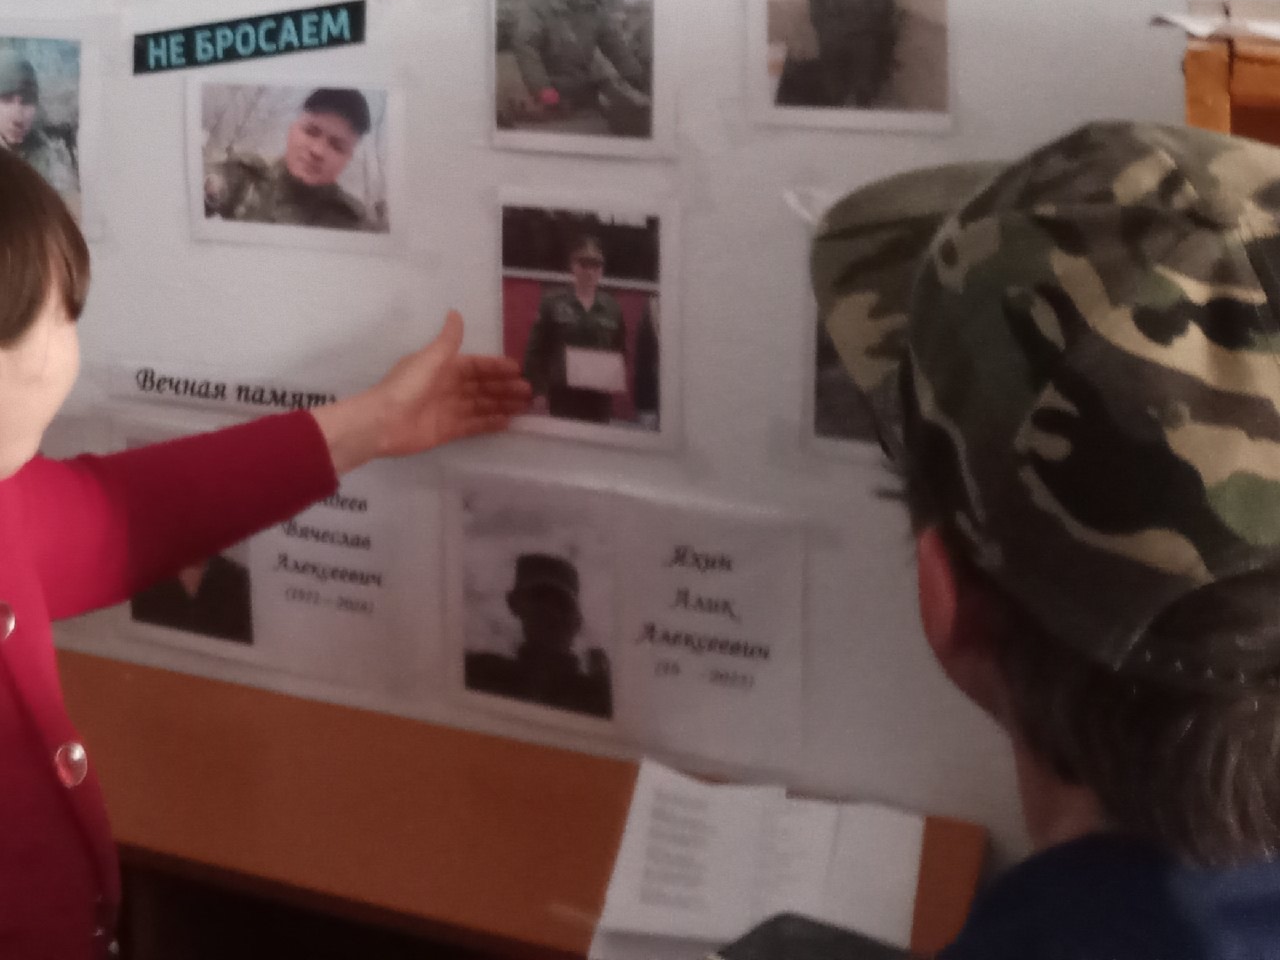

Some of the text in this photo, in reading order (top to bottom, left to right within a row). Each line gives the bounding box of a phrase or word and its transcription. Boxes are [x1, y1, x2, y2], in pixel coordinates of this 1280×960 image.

[147, 7, 352, 70] НЕ БРОСАЕМ
[136, 368, 228, 401] Вечная
